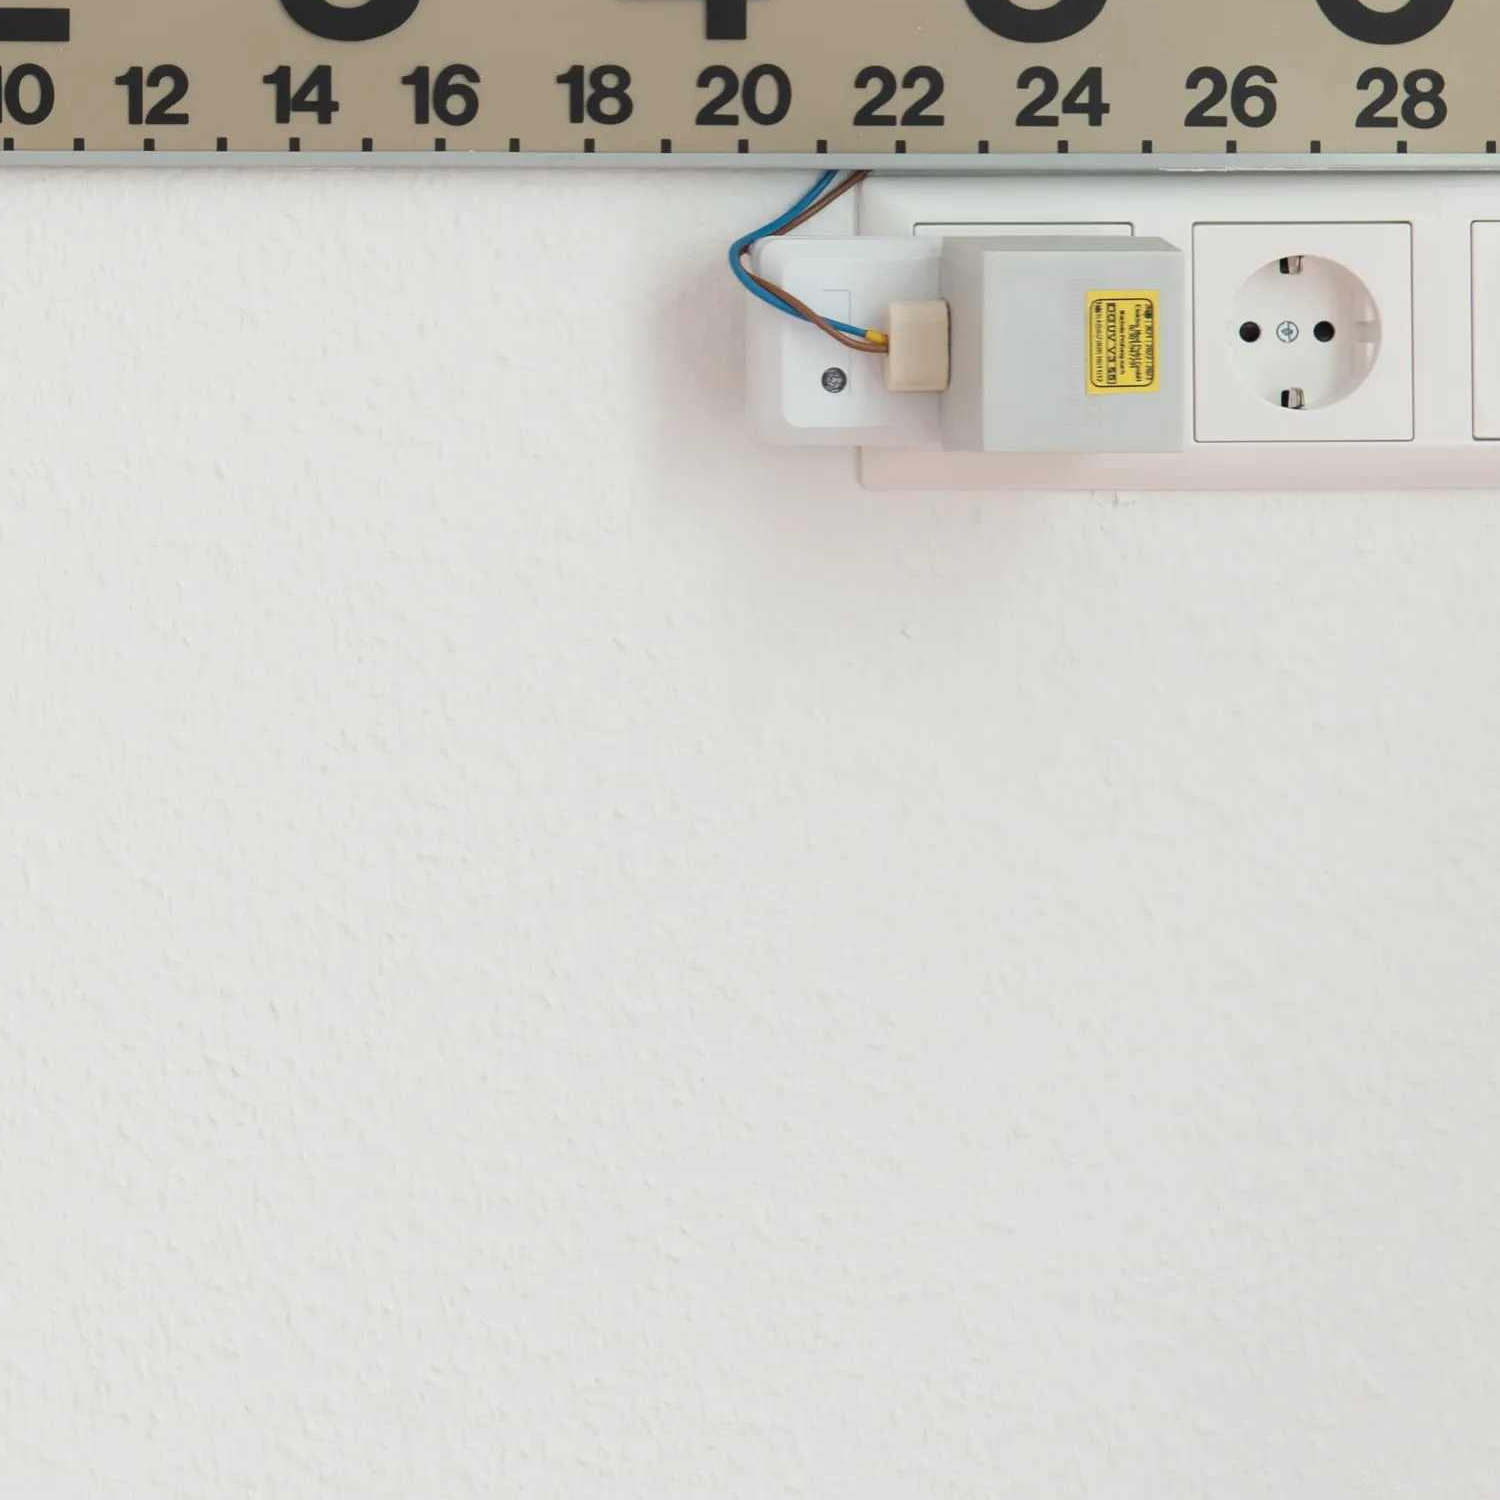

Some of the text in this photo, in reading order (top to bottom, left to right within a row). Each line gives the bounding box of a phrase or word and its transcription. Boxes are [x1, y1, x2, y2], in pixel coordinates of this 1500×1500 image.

[114, 63, 190, 125] 12
[262, 64, 340, 125] 14
[401, 63, 481, 127] 16
[556, 64, 634, 125] 18
[695, 63, 792, 126] 20
[852, 65, 945, 127] 22
[1015, 65, 1110, 127] 24
[1184, 65, 1278, 128] 26
[1355, 67, 1448, 130] 28
